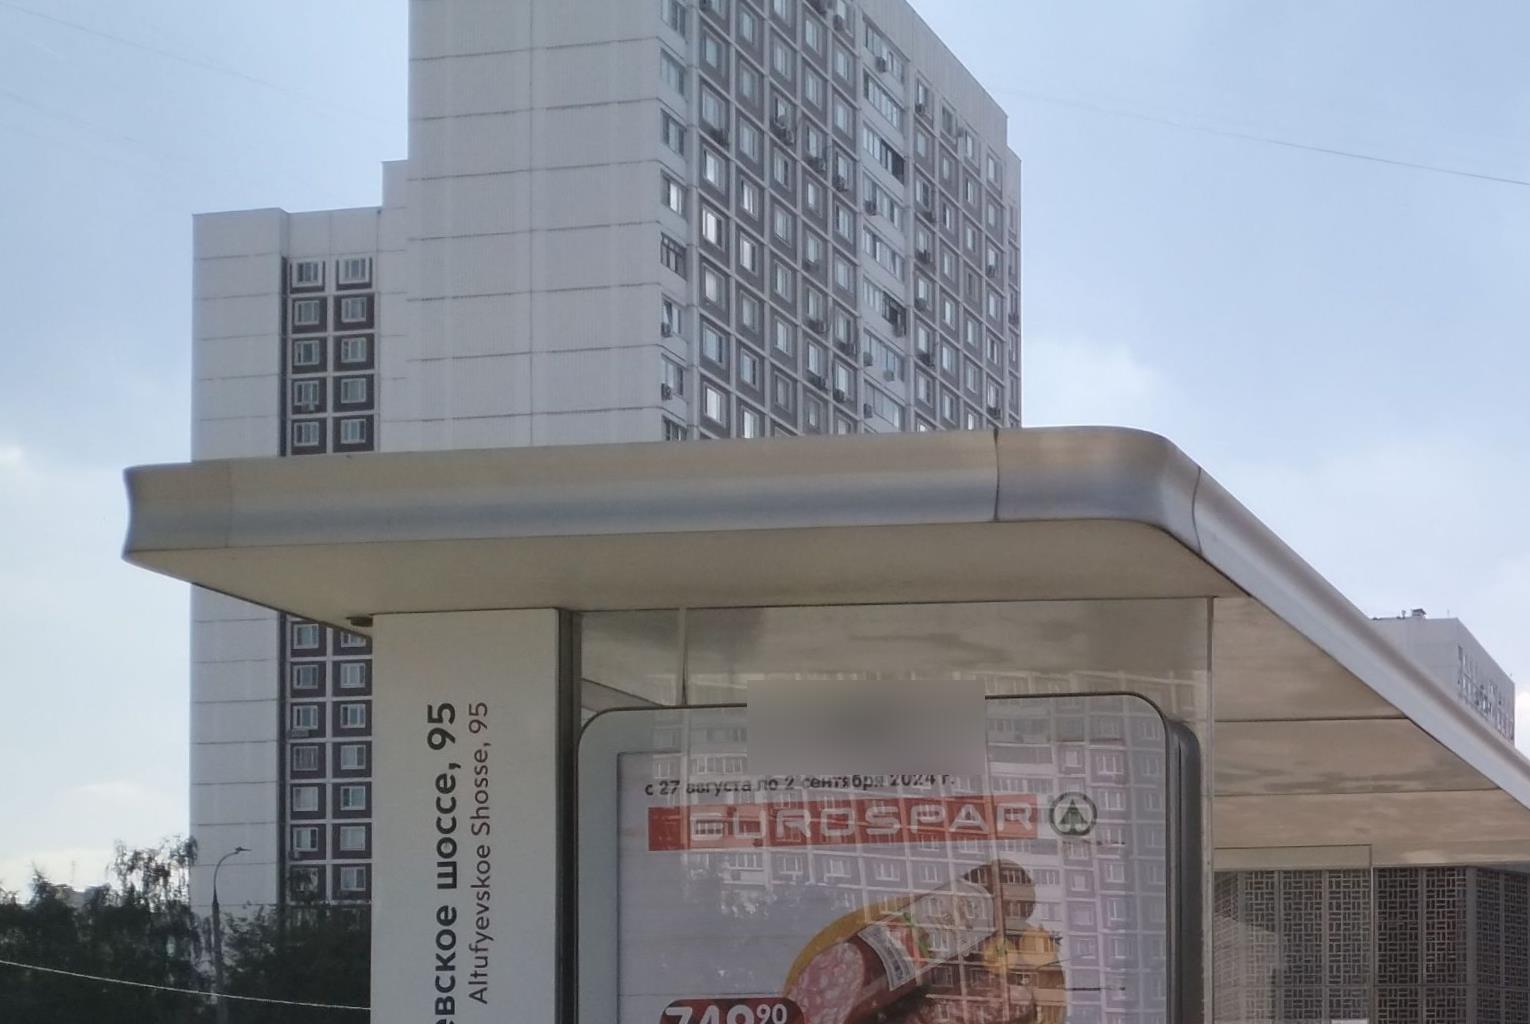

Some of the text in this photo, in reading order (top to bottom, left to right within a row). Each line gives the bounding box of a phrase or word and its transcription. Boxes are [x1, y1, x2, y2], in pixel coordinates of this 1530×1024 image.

[427, 702, 456, 751] 95
[659, 780, 681, 796] 27
[785, 776, 794, 791] 2
[435, 762, 462, 891] шоссе,
[689, 802, 1033, 841] EUROSPAR
[468, 702, 495, 1005] Altufyevskoe Shosse, 95
